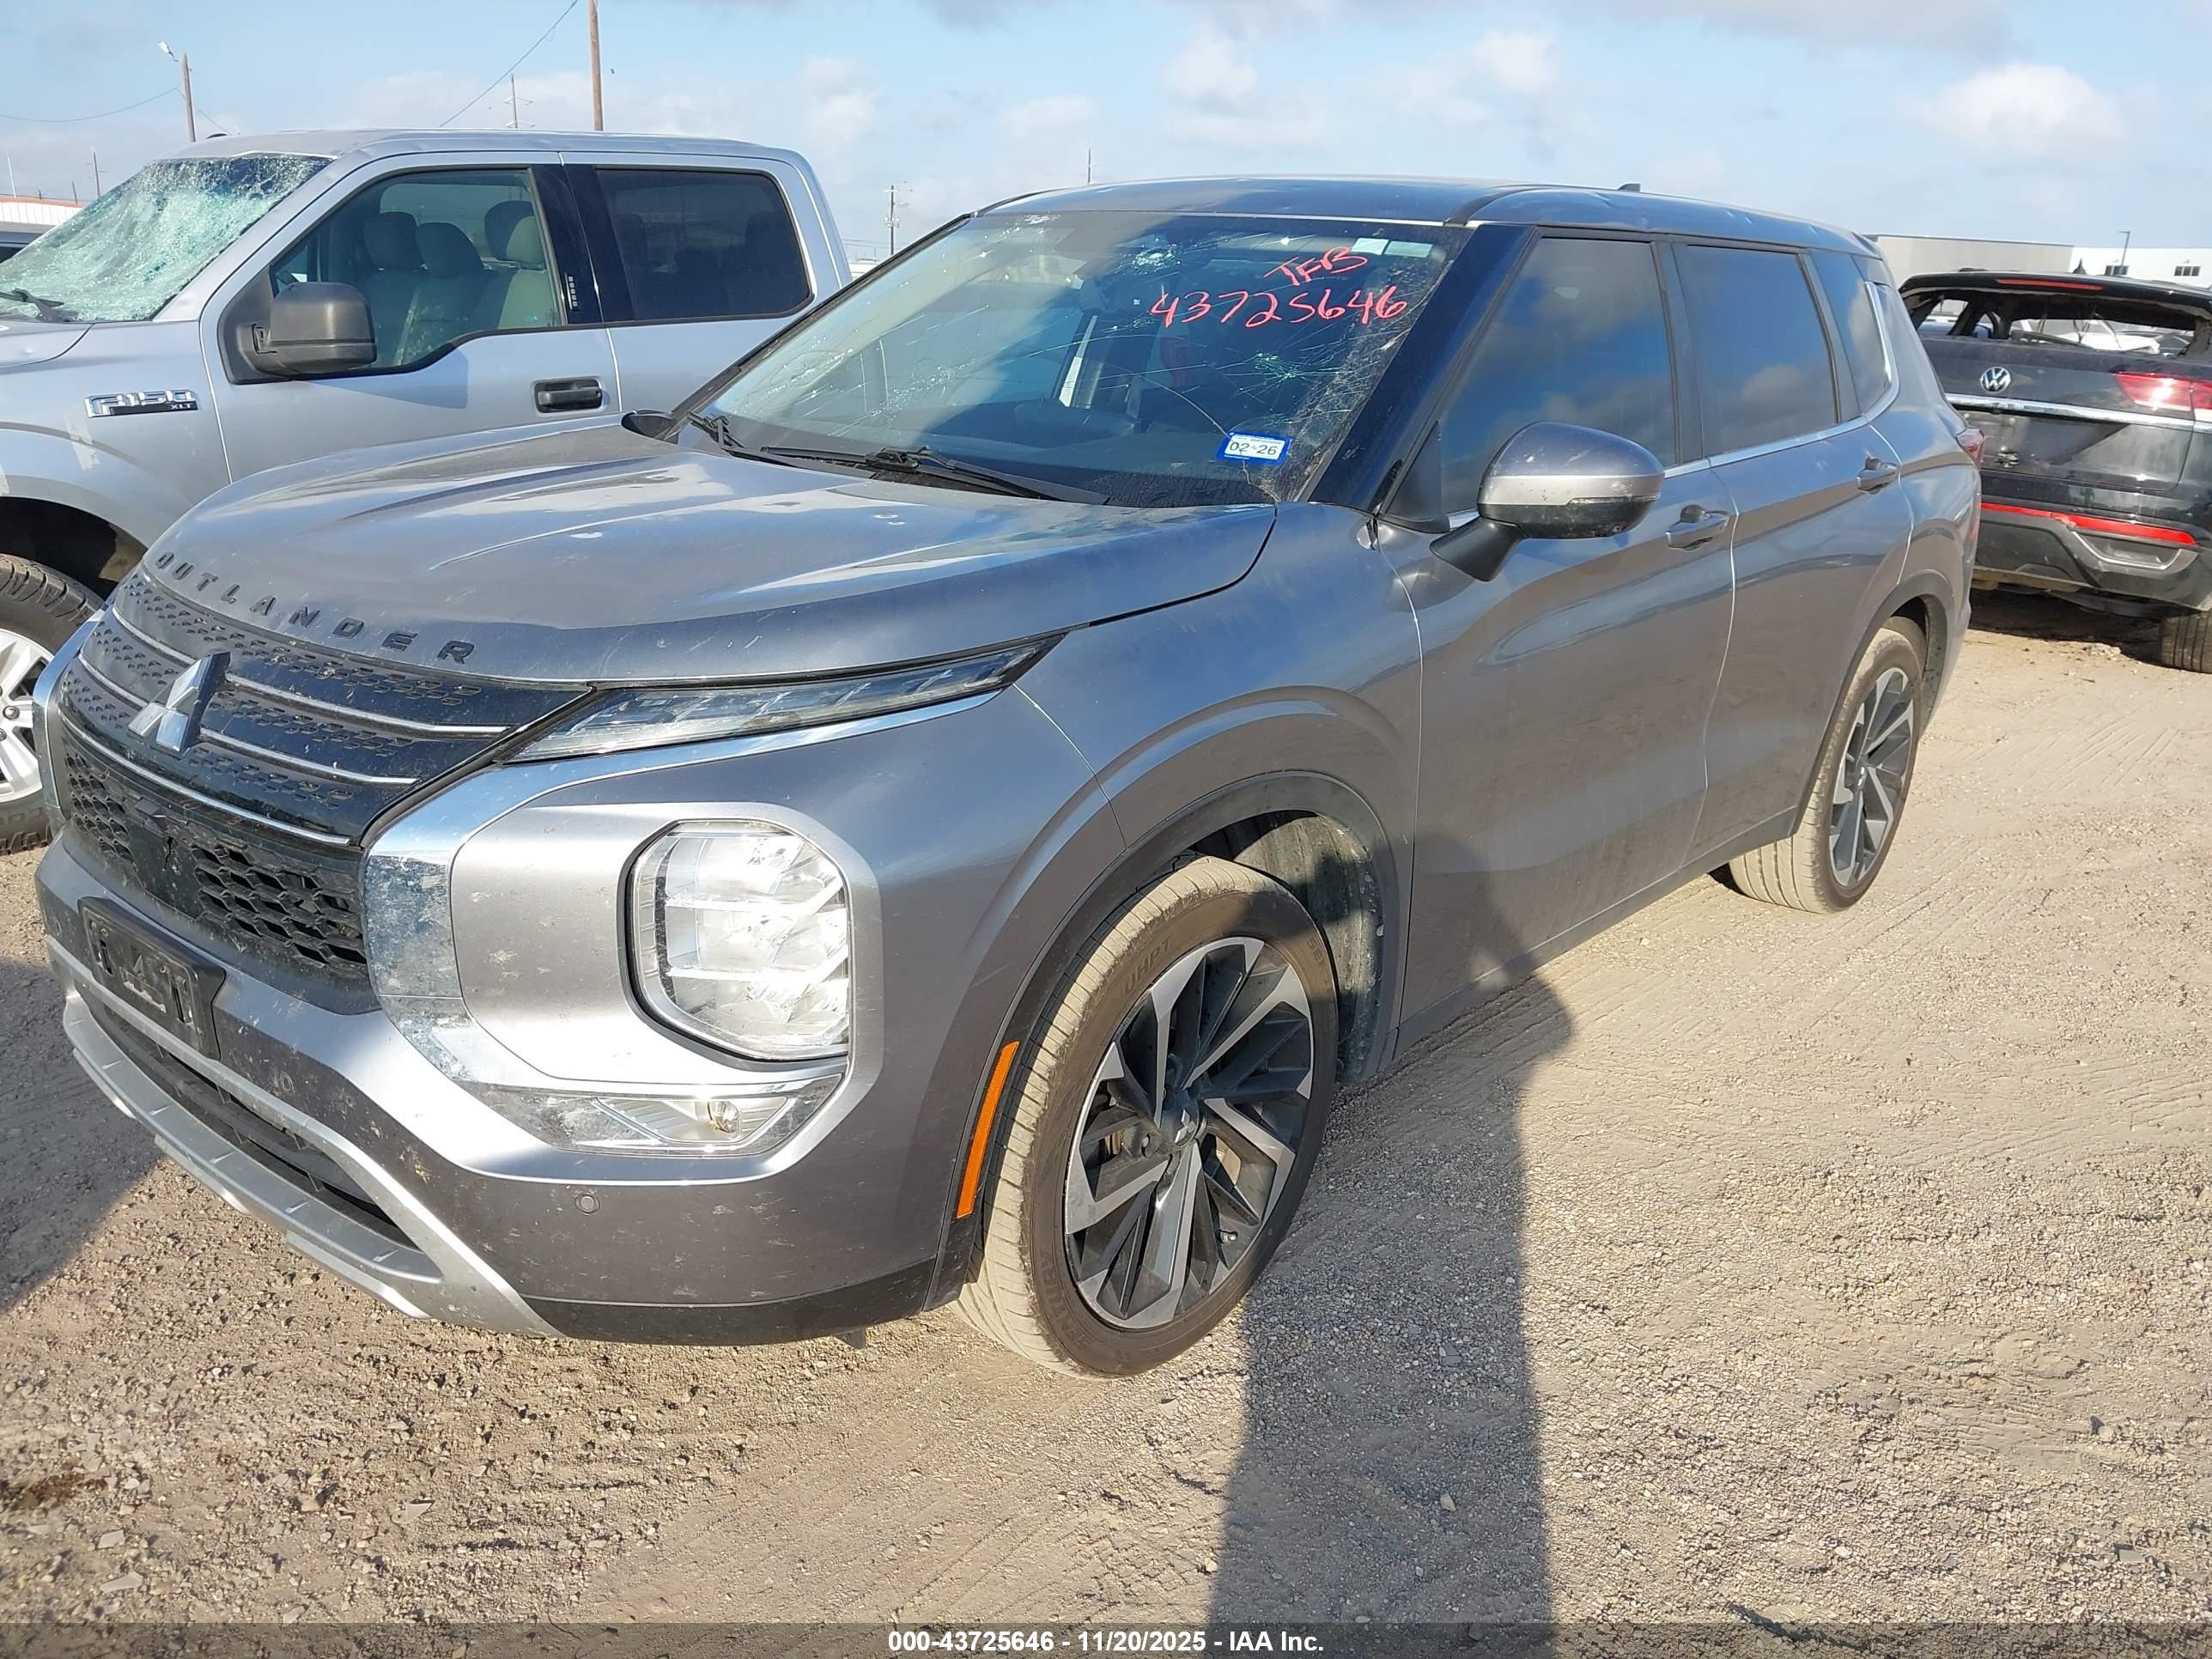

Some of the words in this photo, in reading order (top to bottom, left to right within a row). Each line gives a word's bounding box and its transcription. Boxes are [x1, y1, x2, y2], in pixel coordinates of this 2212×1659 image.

[1150, 284, 1408, 328] 43725646
[1256, 444, 1279, 455] 26
[155, 551, 476, 665] OUTLANDER
